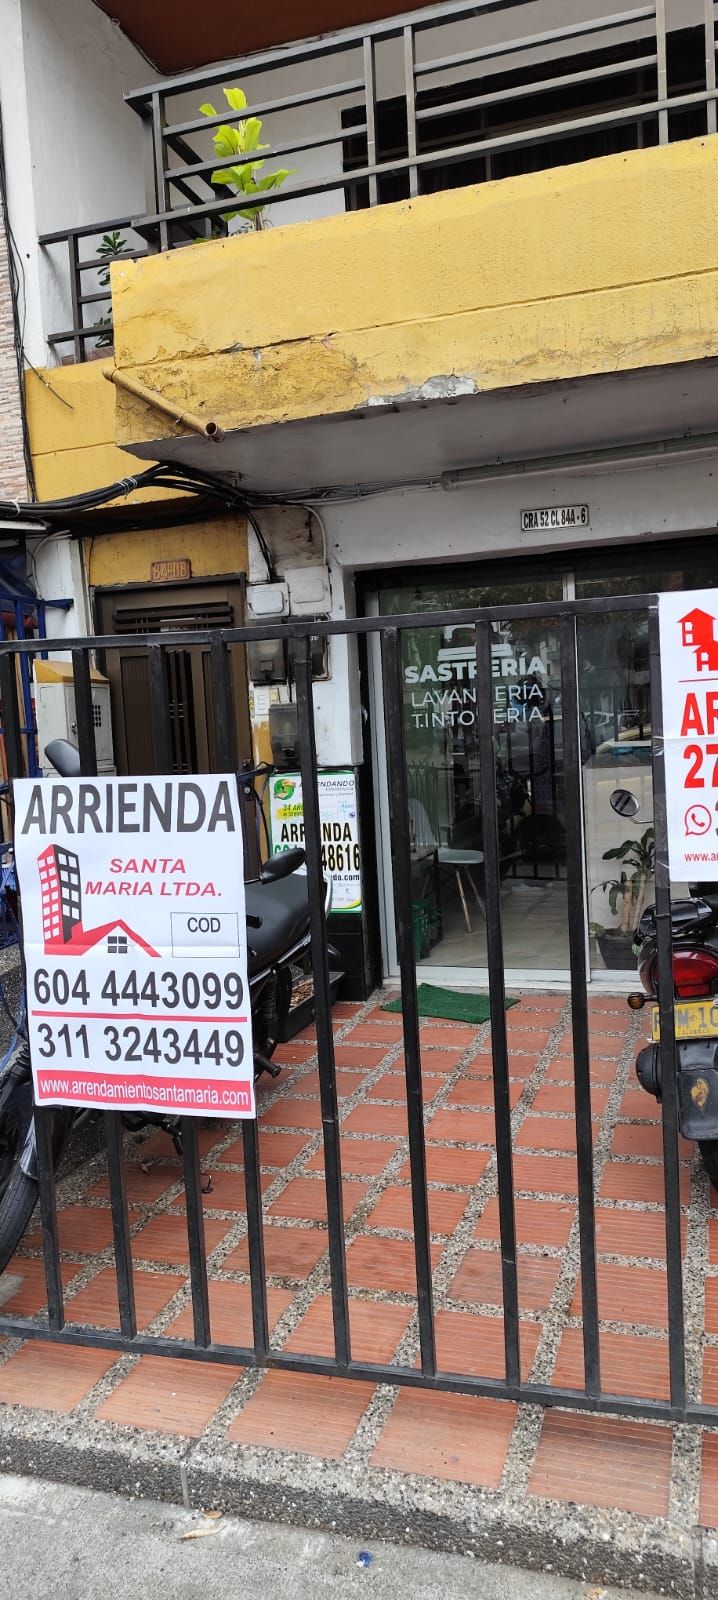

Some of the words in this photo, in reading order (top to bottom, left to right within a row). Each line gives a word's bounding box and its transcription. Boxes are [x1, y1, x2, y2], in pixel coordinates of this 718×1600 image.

[523, 511, 539, 529] CRA
[540, 510, 550, 527] 52
[550, 510, 560, 526] CL
[561, 508, 576, 525] 84A
[580, 507, 586, 524] 6
[411, 681, 544, 708] LAVANERÍA
[411, 704, 546, 729] TINTOERÍA
[21, 780, 236, 835] ARRIENDA
[281, 822, 353, 843] ARRNDA
[109, 858, 187, 875] SANTA
[84, 881, 154, 896] MARIA
[159, 882, 223, 897] LTDA.
[186, 916, 222, 934] COD
[33, 968, 91, 1006] 604
[101, 969, 244, 1010] 4443099
[37, 1023, 90, 1059] 311
[103, 1025, 246, 1068] 3243449
[40, 1078, 249, 1106] www.arrendamientosantamaria.com
